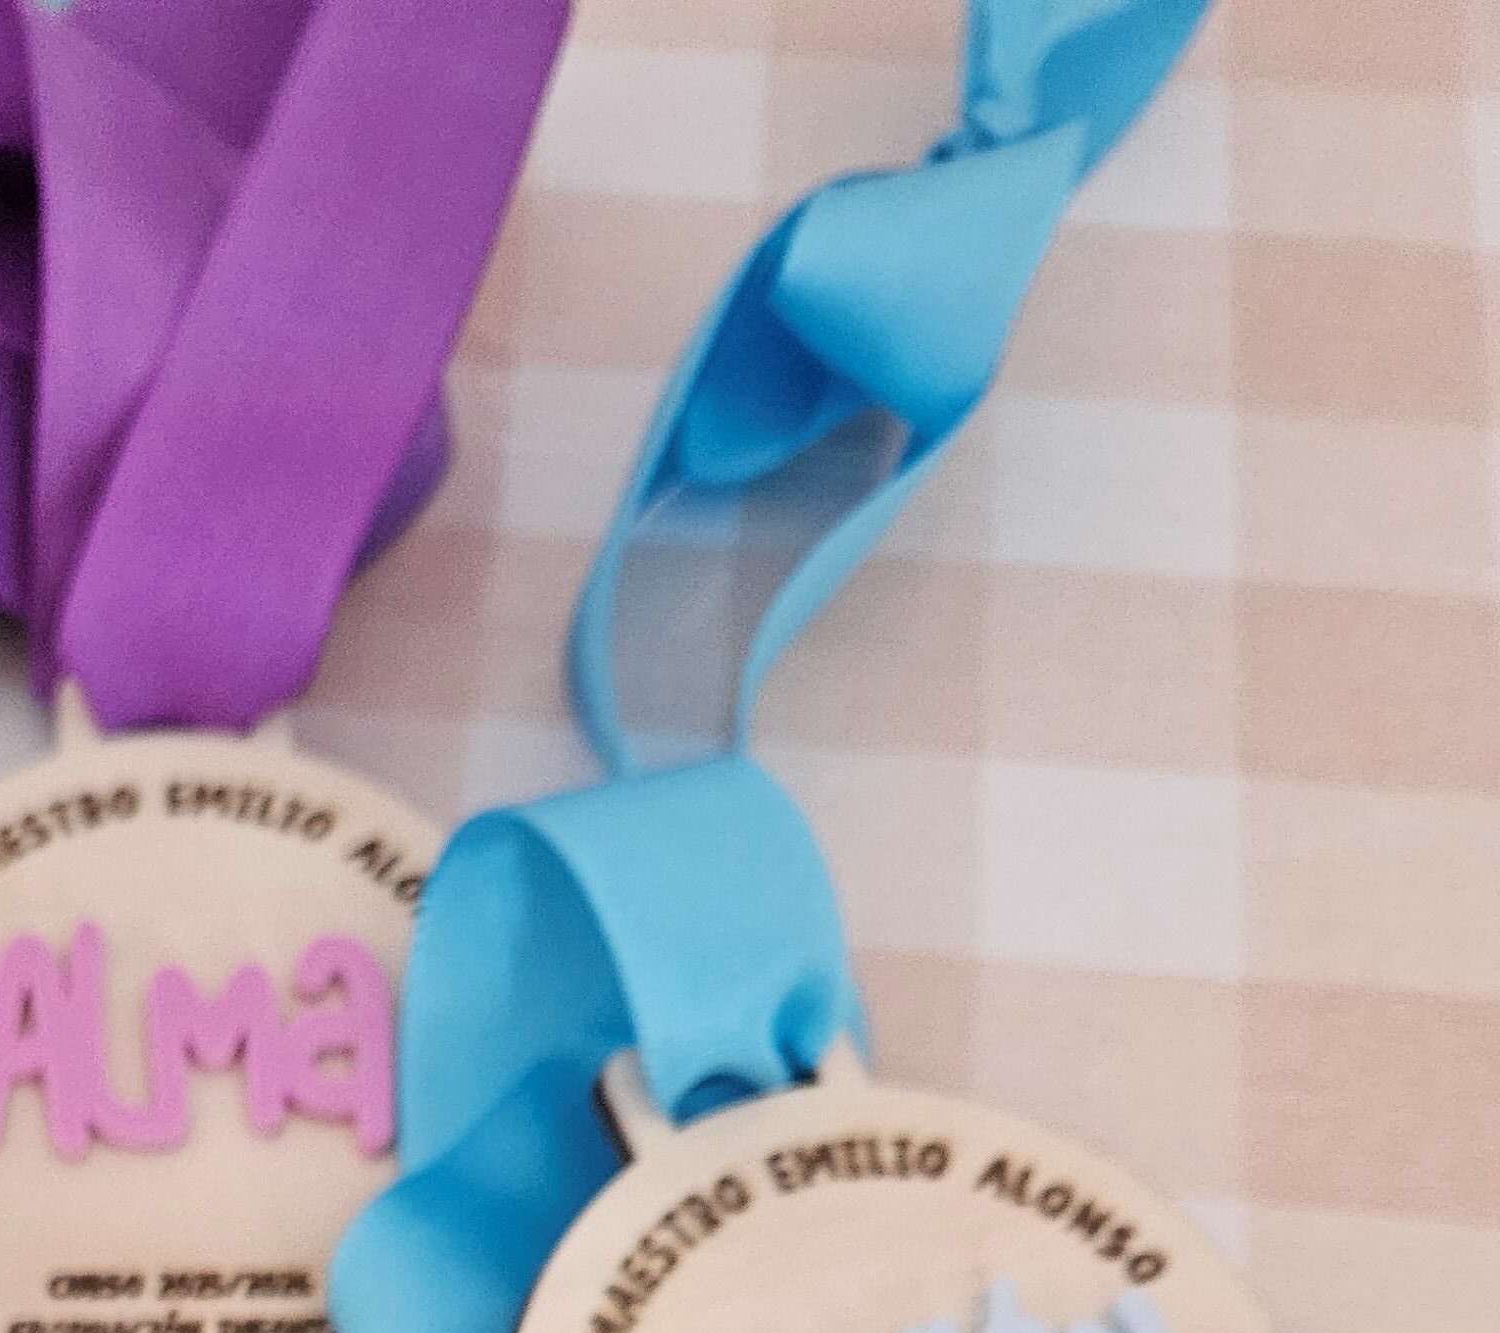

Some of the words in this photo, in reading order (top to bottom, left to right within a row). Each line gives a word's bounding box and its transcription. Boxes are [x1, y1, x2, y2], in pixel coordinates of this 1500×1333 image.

[164, 782, 337, 841] EMILIO
[345, 838, 427, 915] ALO
[764, 1133, 952, 1193] EMILIO
[974, 1154, 1171, 1285] ALONSO
